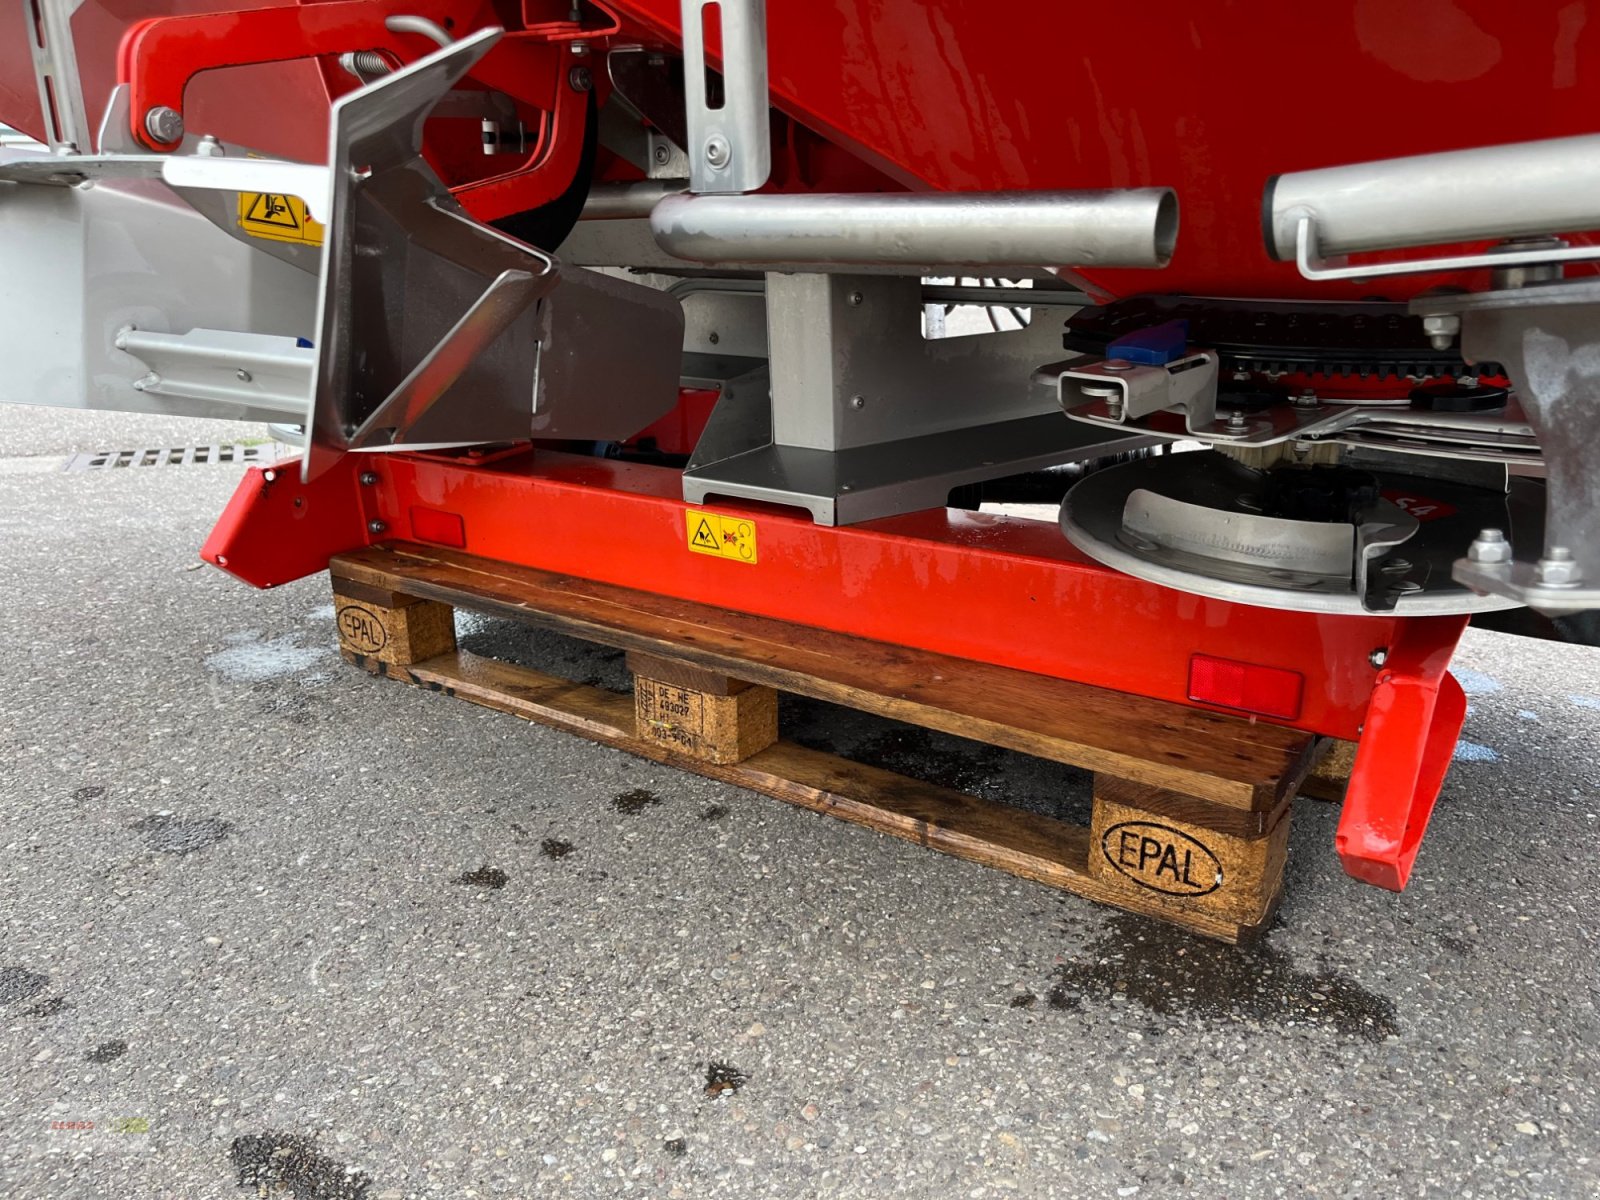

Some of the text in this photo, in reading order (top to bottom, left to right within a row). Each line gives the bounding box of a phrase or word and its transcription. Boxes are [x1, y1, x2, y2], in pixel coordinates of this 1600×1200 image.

[343, 612, 381, 646] EPAL
[659, 686, 669, 699] DE
[1119, 830, 1202, 889] EPAL
